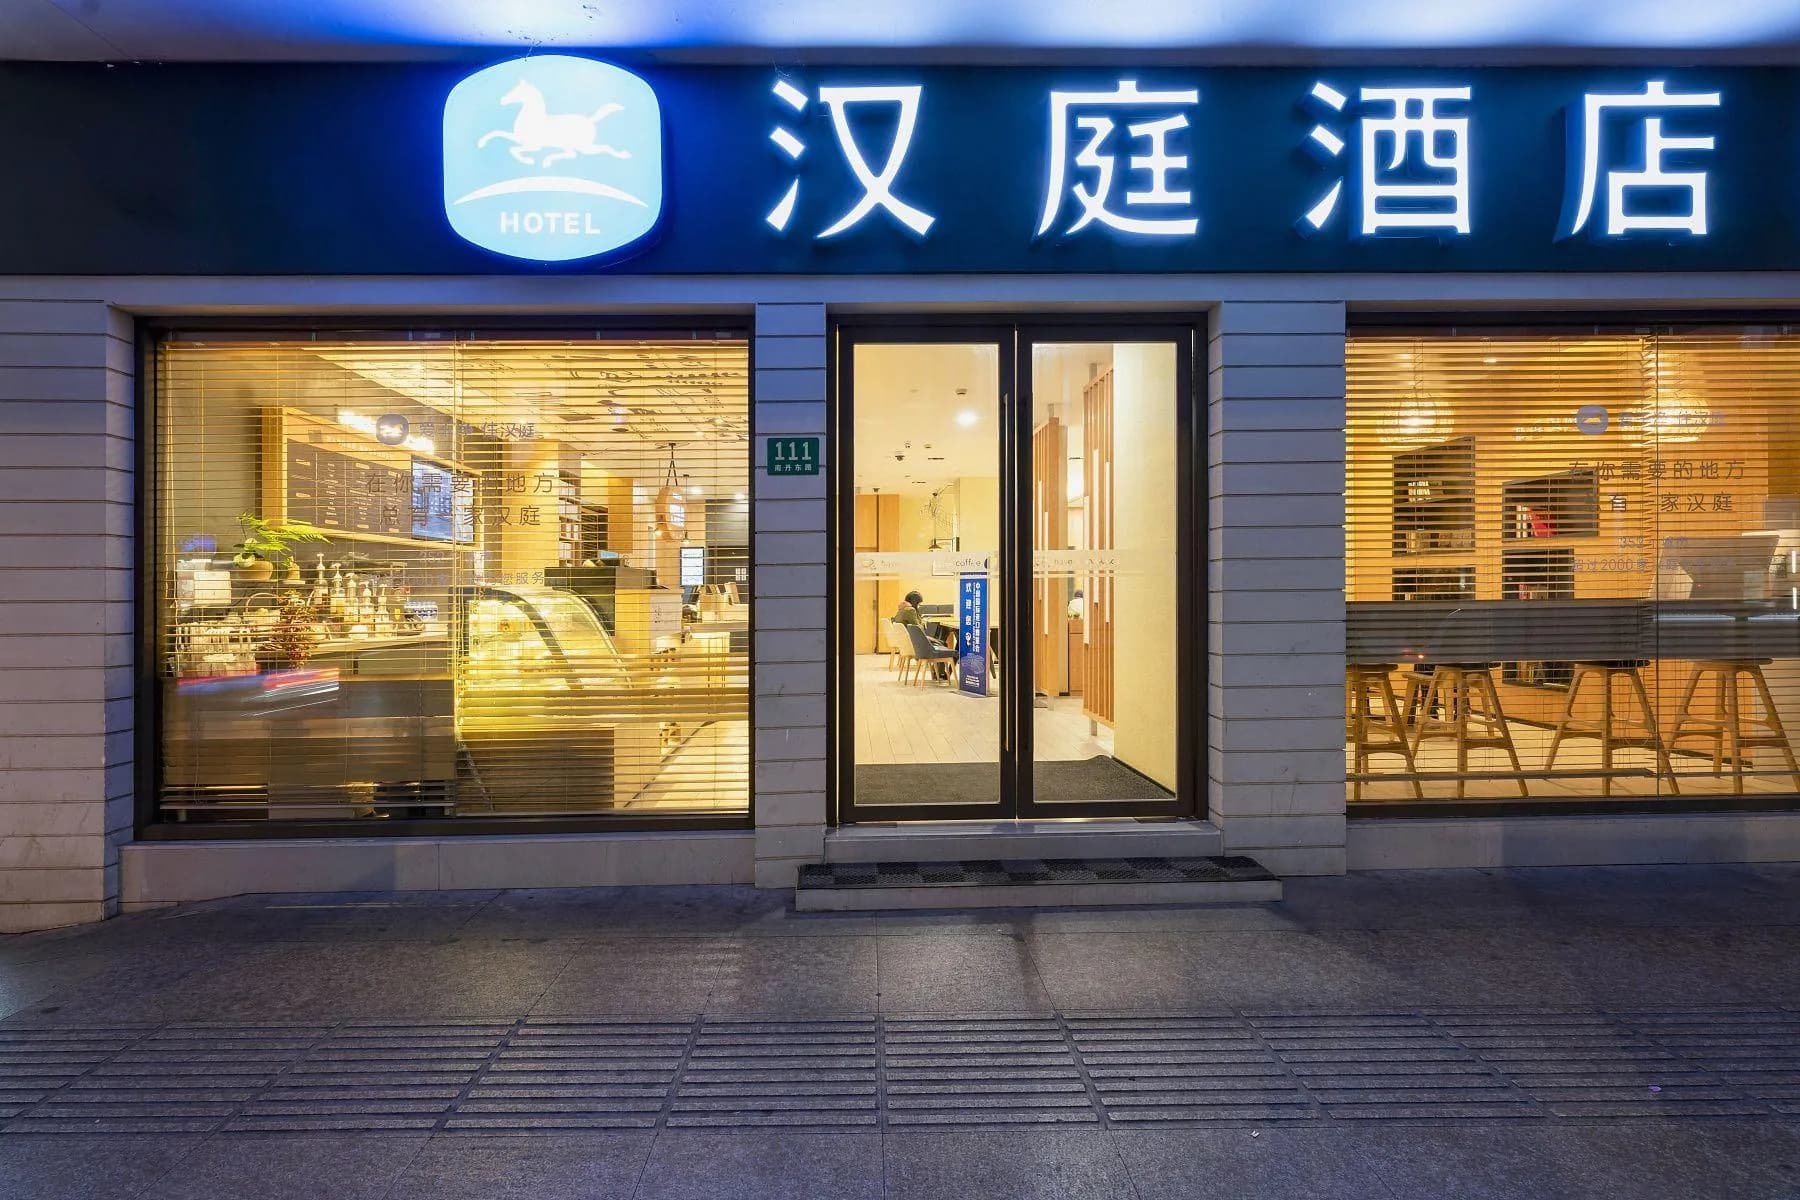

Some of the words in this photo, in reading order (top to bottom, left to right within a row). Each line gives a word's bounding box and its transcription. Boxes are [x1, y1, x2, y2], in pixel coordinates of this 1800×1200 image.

[766, 79, 1721, 240] 汉庭酒店
[500, 211, 601, 235] HOTEL
[775, 441, 812, 461] 111
[1569, 459, 1745, 481] 在你需要的地方
[1584, 492, 1733, 512] 有家汉庭
[382, 504, 542, 527] 总有家汉庭
